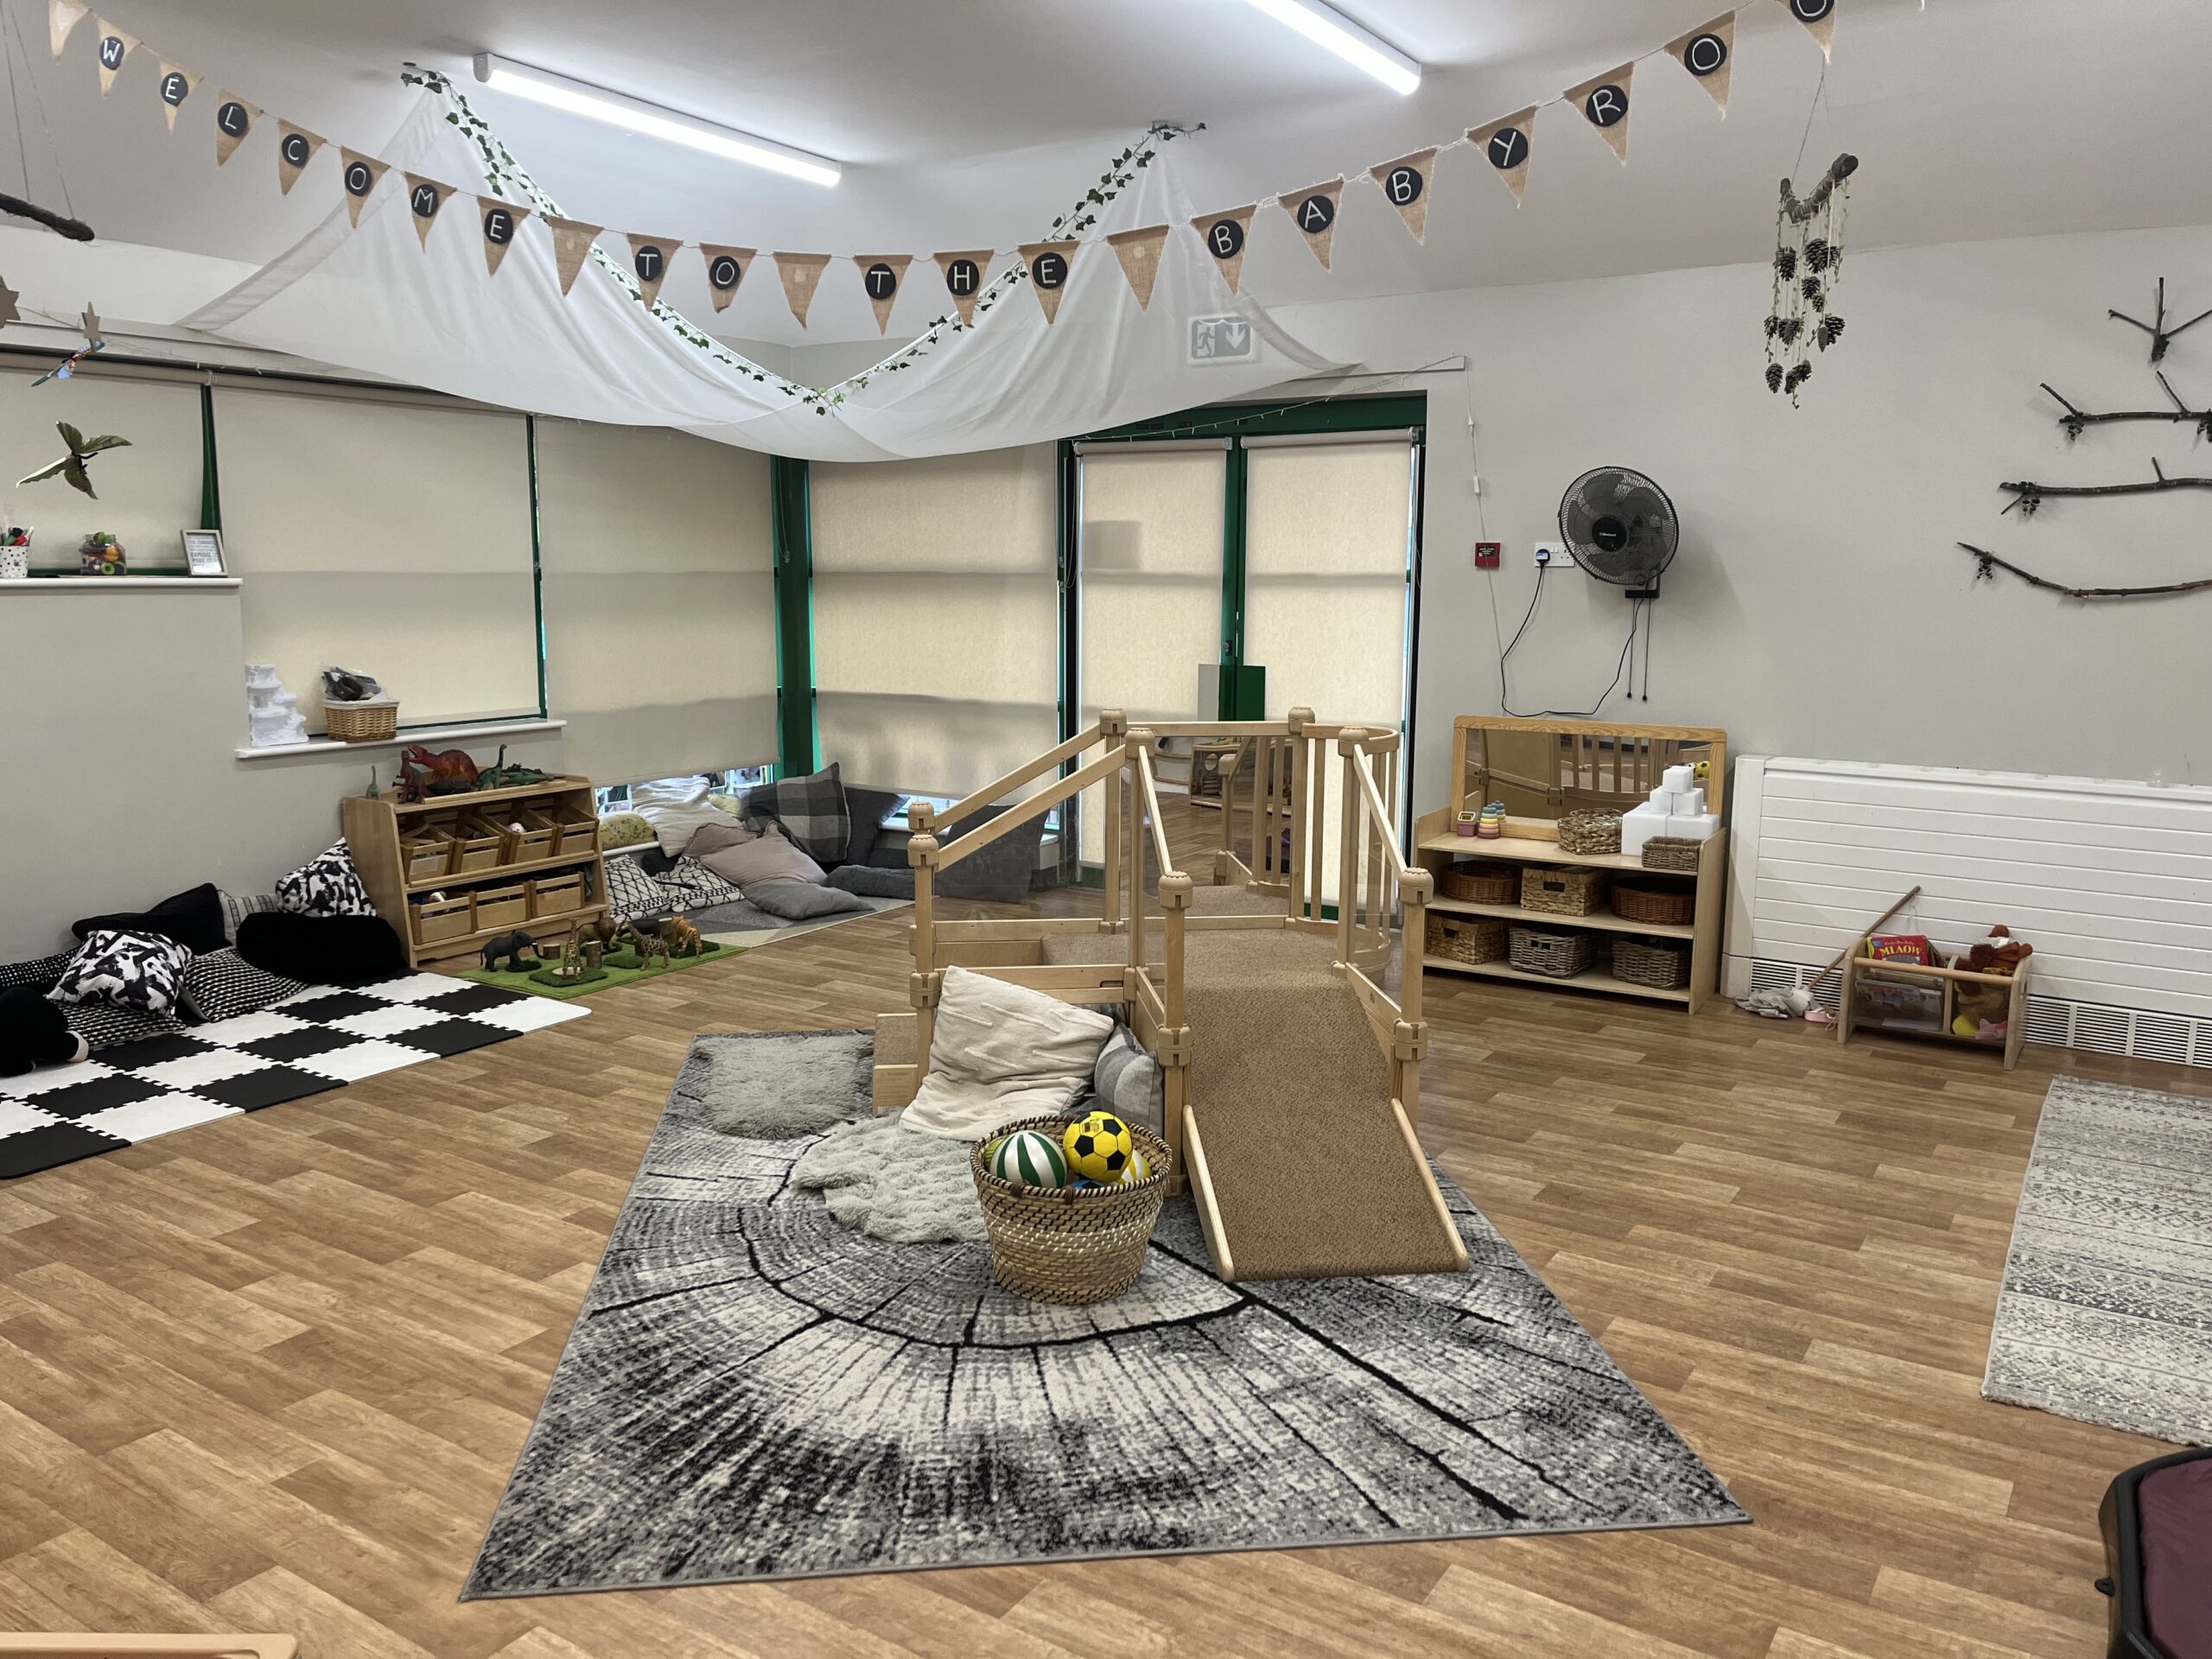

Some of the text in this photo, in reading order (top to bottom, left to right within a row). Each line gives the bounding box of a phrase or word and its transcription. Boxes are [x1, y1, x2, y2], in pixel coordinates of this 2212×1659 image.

[103, 39, 505, 239] WELCOME
[639, 252, 735, 285] TO
[870, 258, 1057, 294] THE
[1214, 130, 1517, 254] BABY
[1878, 944, 1923, 957] MIAOW
